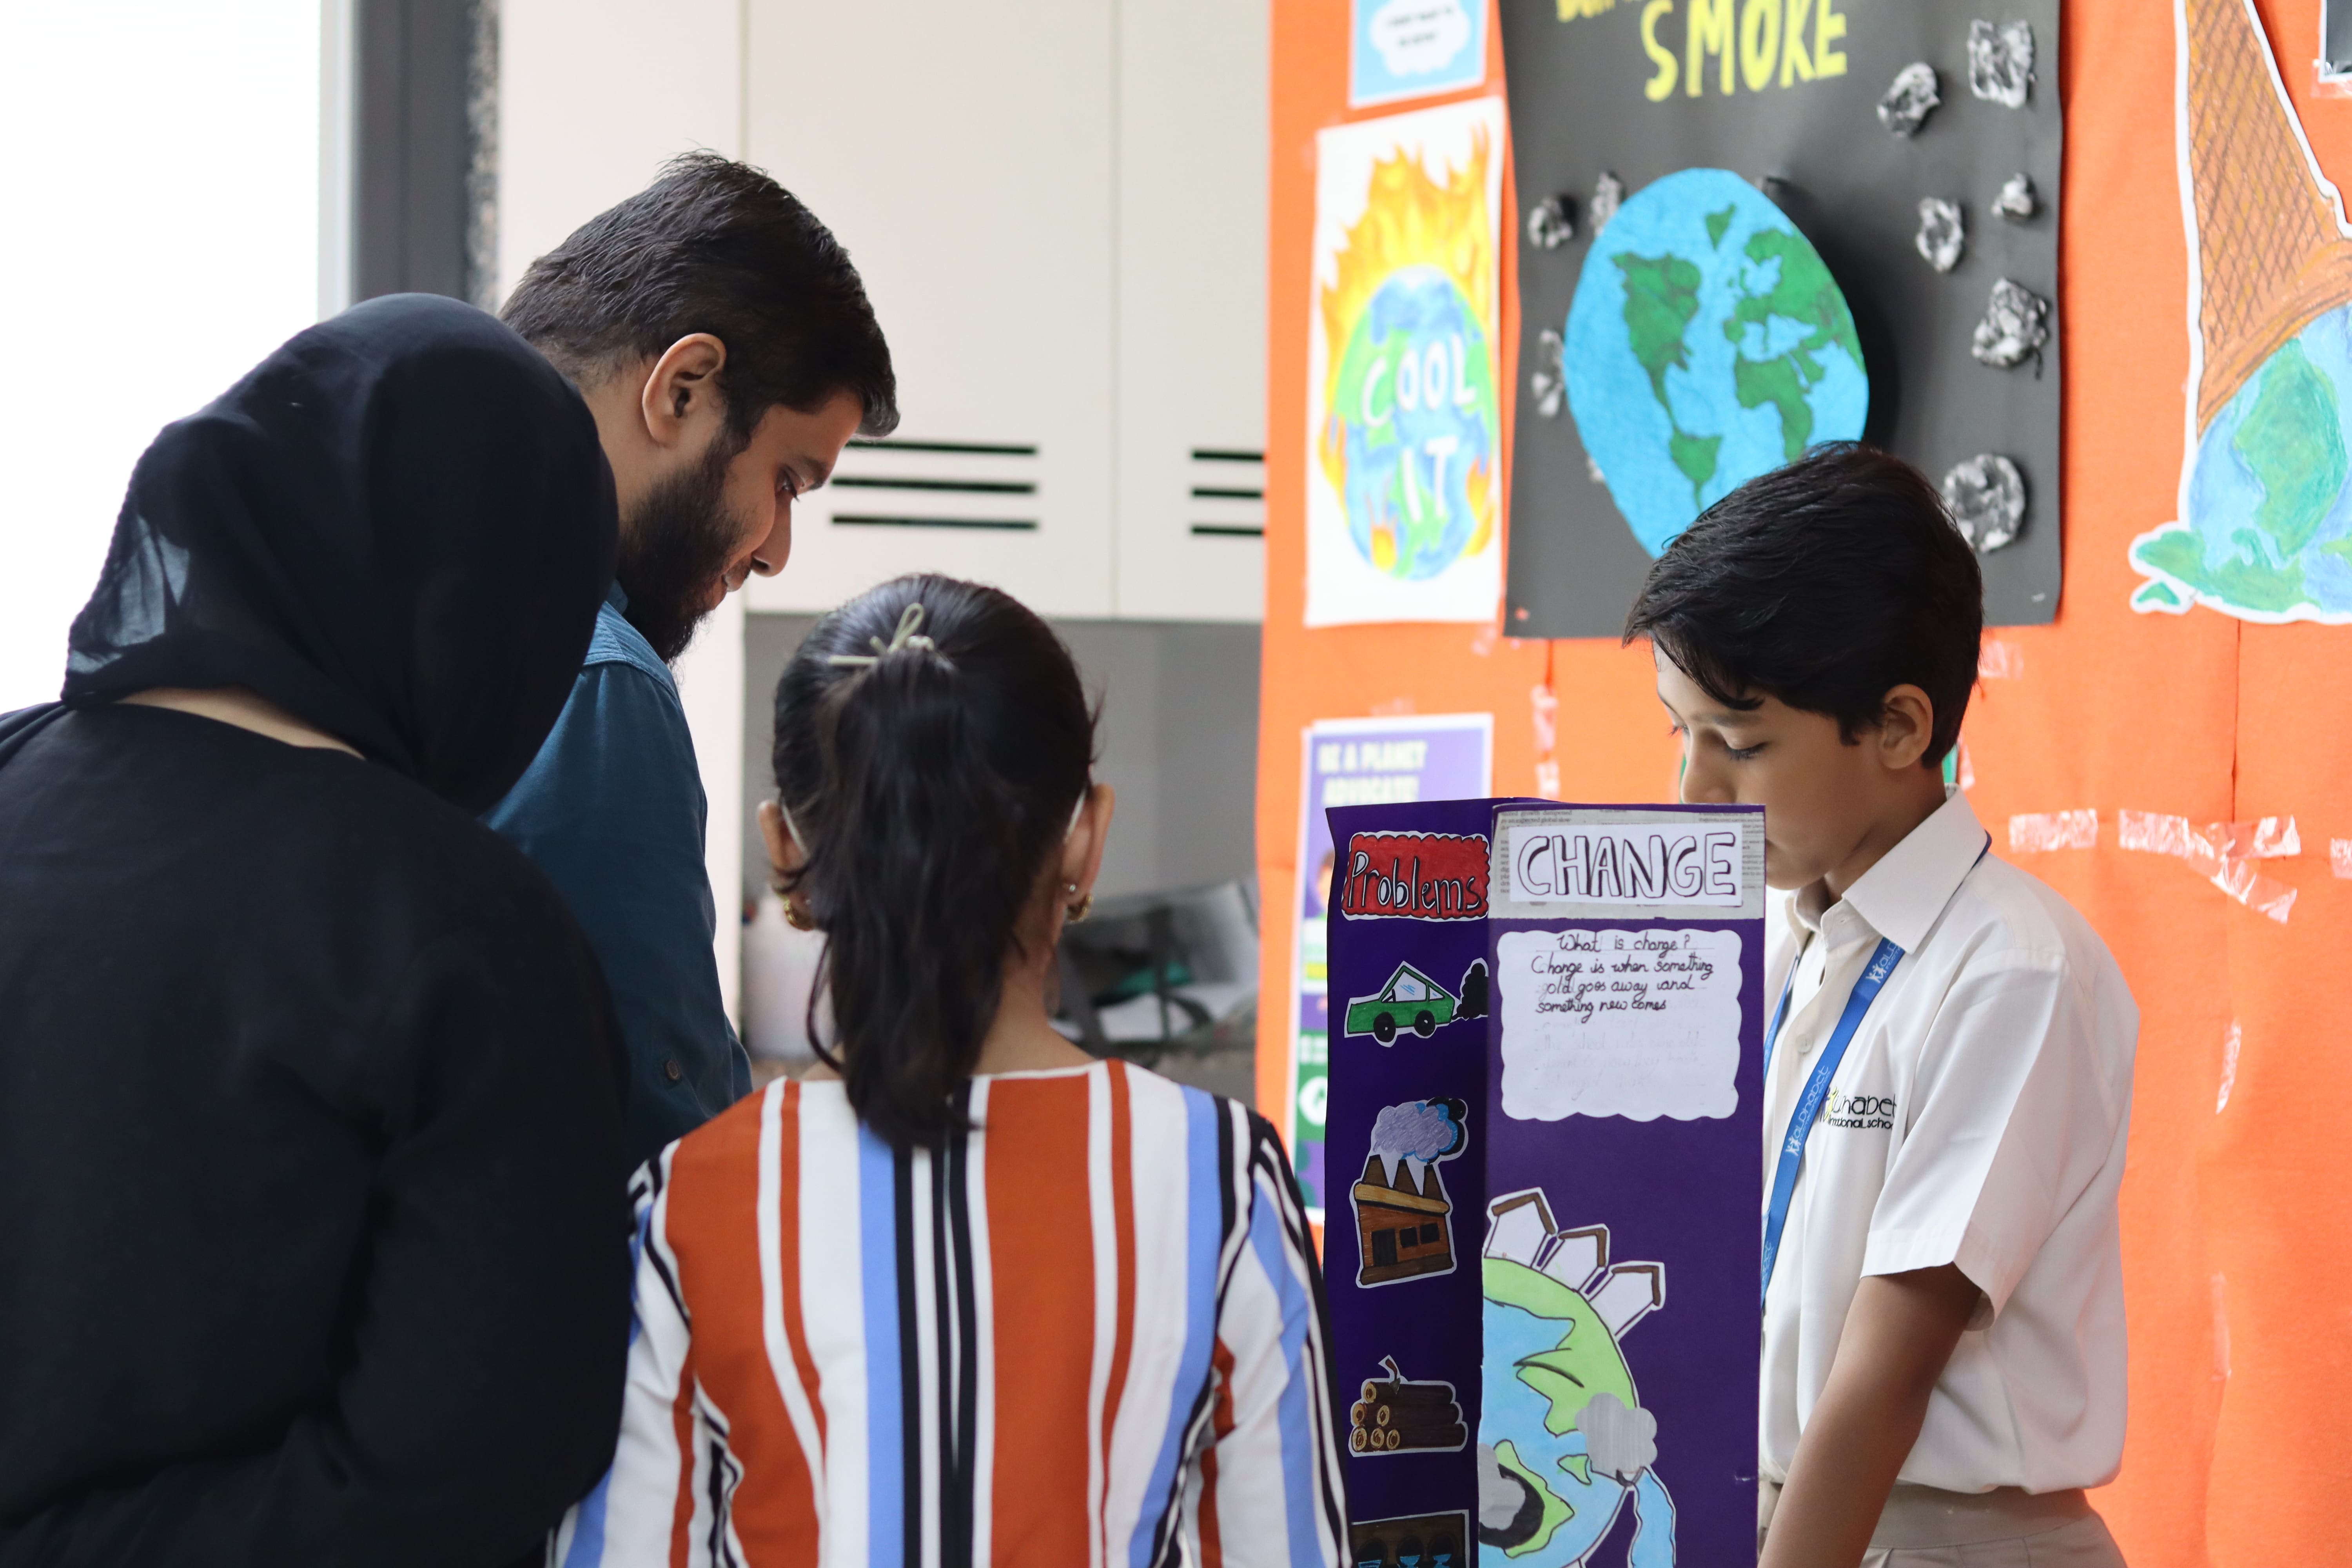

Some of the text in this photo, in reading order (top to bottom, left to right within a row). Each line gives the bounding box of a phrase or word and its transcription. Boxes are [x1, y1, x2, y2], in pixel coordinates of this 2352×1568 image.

[1640, 0, 1847, 101] SMOKE
[1361, 333, 1476, 428] COOL
[1402, 435, 1458, 523] IT
[1348, 851, 1482, 914] Problems
[1518, 832, 1735, 898] CHANGE
[1532, 952, 1714, 980] Change is when something
[1557, 932, 1601, 952] What
[1615, 935, 1624, 950] is
[1536, 998, 1666, 1023] something new comes
[1578, 982, 1606, 1000] goes
[1612, 982, 1648, 1001] away
[1657, 975, 1695, 990] and
